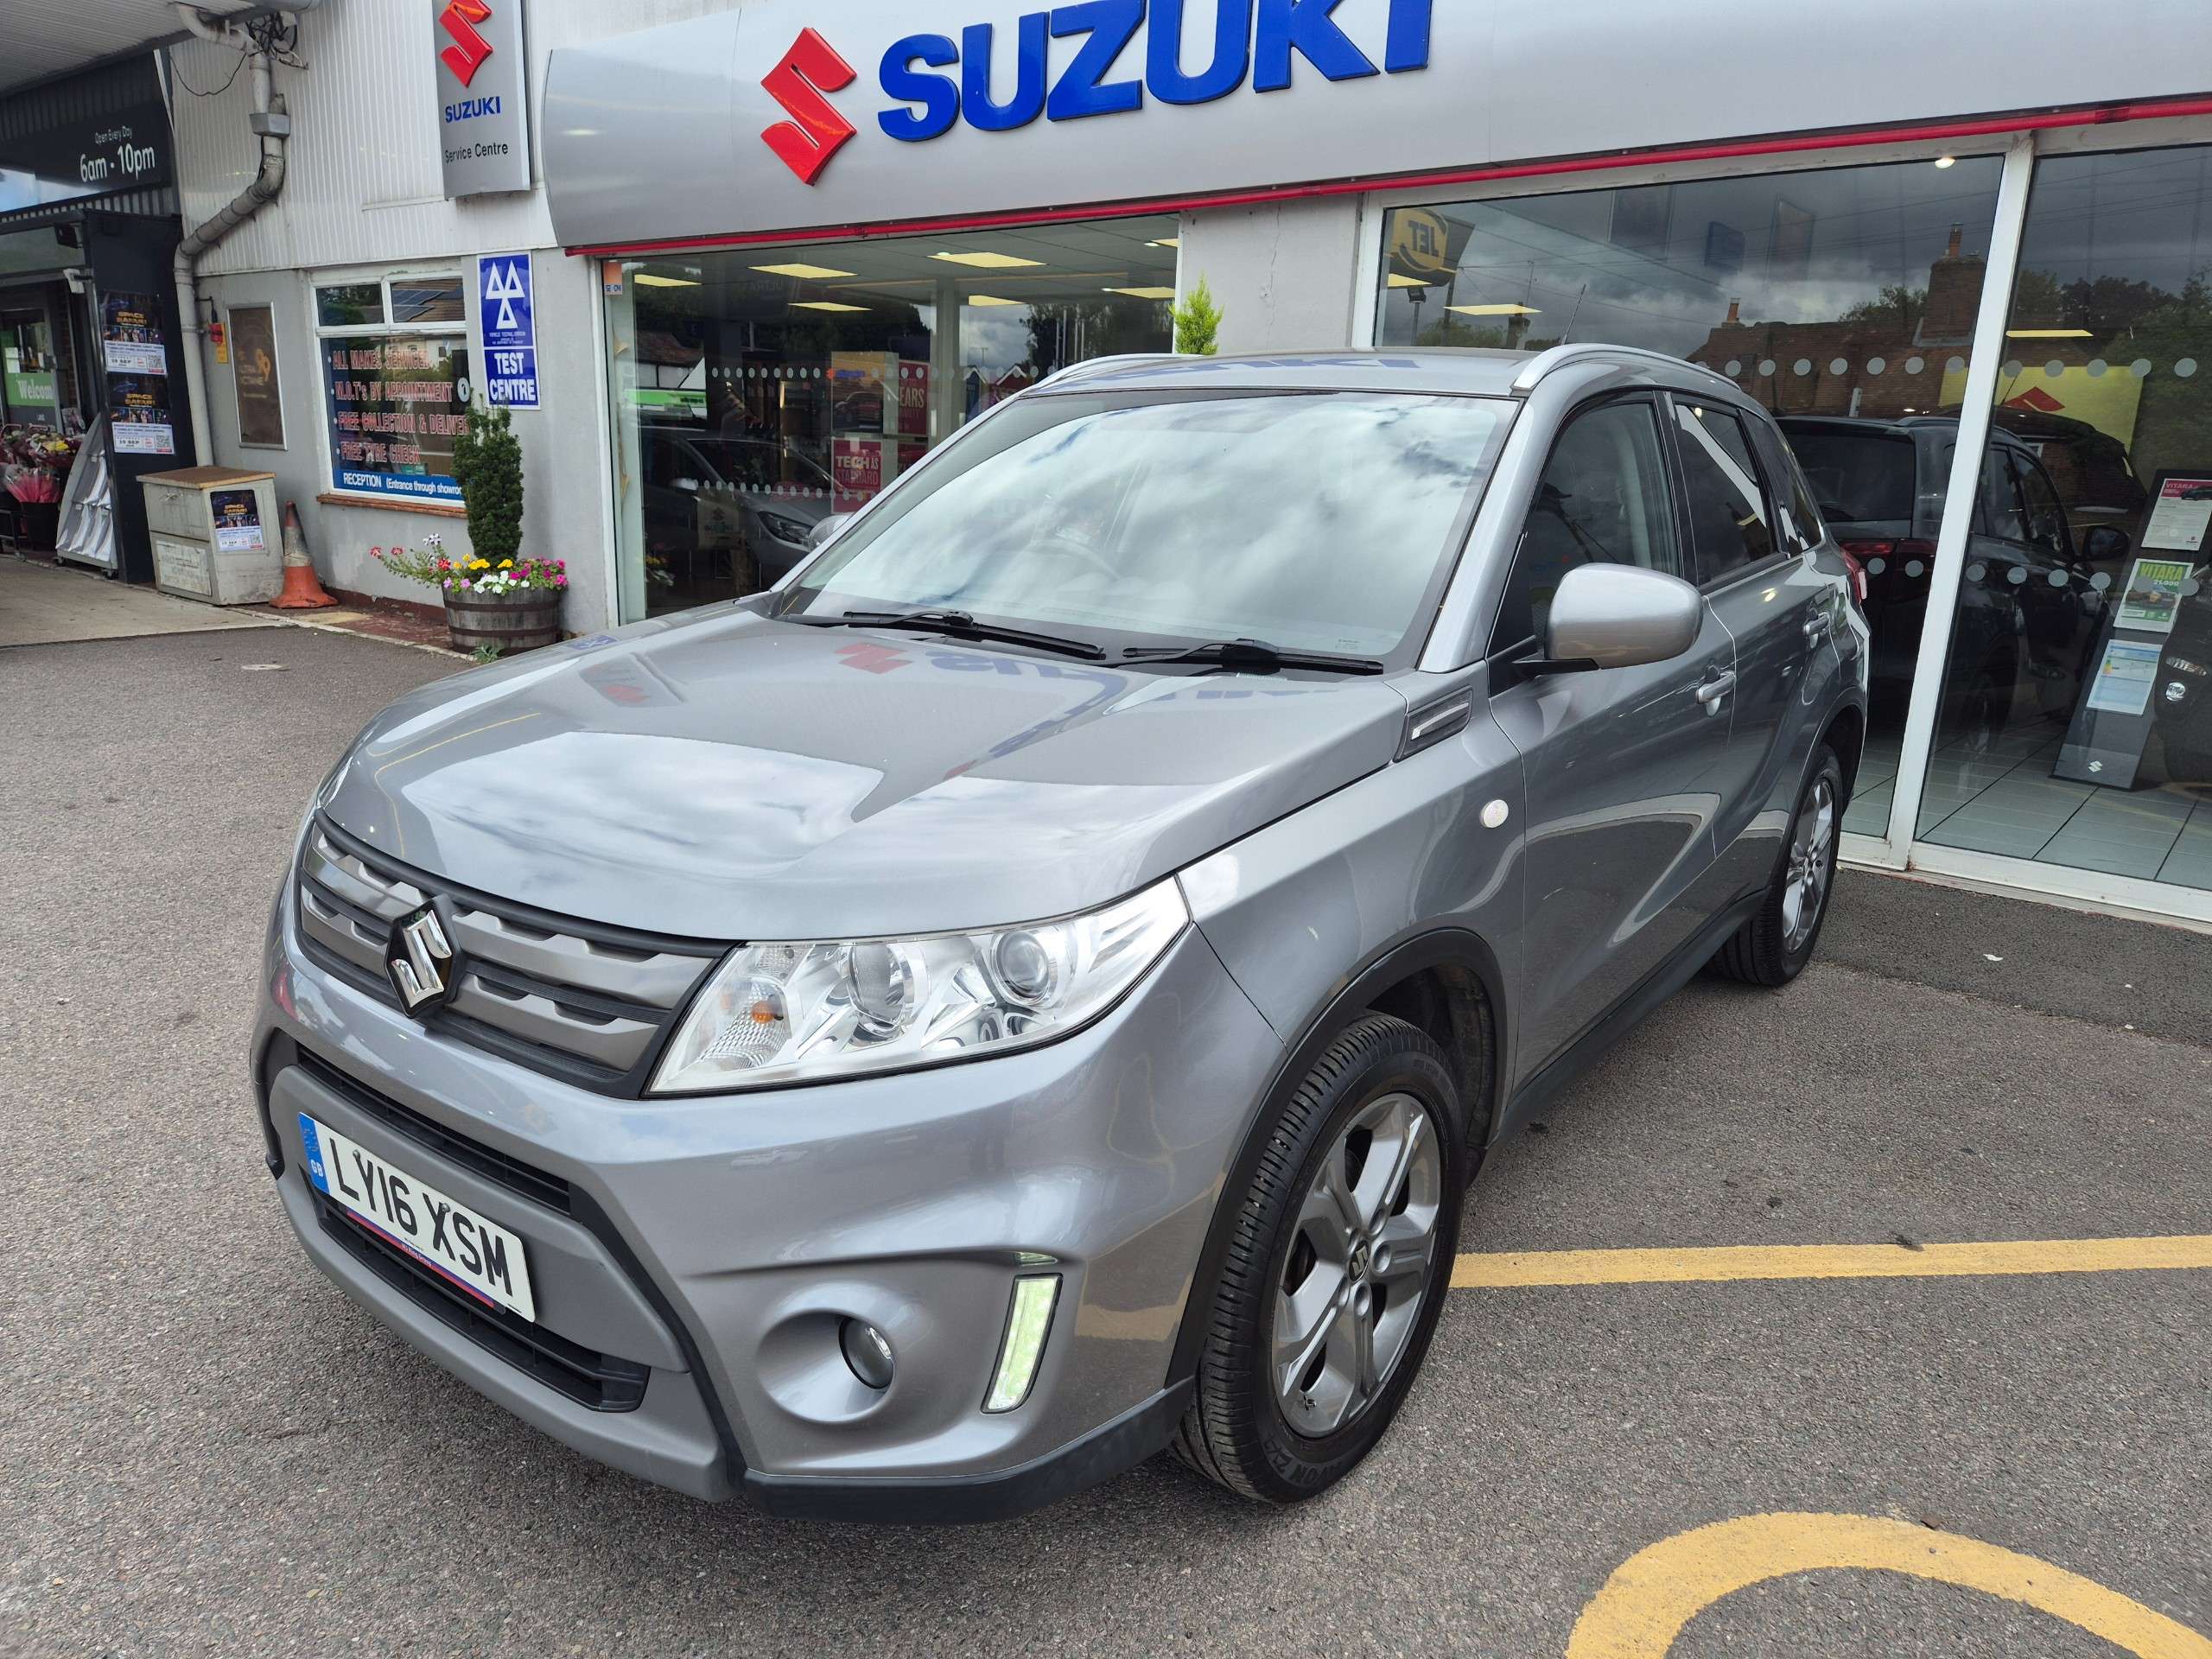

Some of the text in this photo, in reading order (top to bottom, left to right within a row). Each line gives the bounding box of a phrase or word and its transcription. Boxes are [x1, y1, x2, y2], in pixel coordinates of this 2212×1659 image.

[878, 0, 1432, 143] SUZUKI
[445, 96, 501, 124] SUZUKI
[79, 153, 108, 182] 6am
[117, 143, 156, 180] 10pm
[444, 142, 509, 164] Service Centre
[333, 349, 429, 370] ALL MAKES SERVICED
[493, 352, 524, 375] TEST
[16, 378, 54, 400] Welcom
[369, 381, 382, 401] BY
[385, 381, 453, 403] APPOINTMENT
[489, 378, 536, 401] CENTRE
[338, 411, 470, 435] FREE COLLECTION & DELIVER
[340, 442, 420, 464] FREE TYRE CHECK
[836, 455, 870, 469] TECH
[343, 473, 382, 488] RECEPTION
[386, 478, 413, 492] (Entrance
[414, 480, 436, 495] through
[2139, 563, 2184, 582] VITARA
[310, 1159, 324, 1178] GB
[329, 1137, 513, 1298] LY16 XSM
